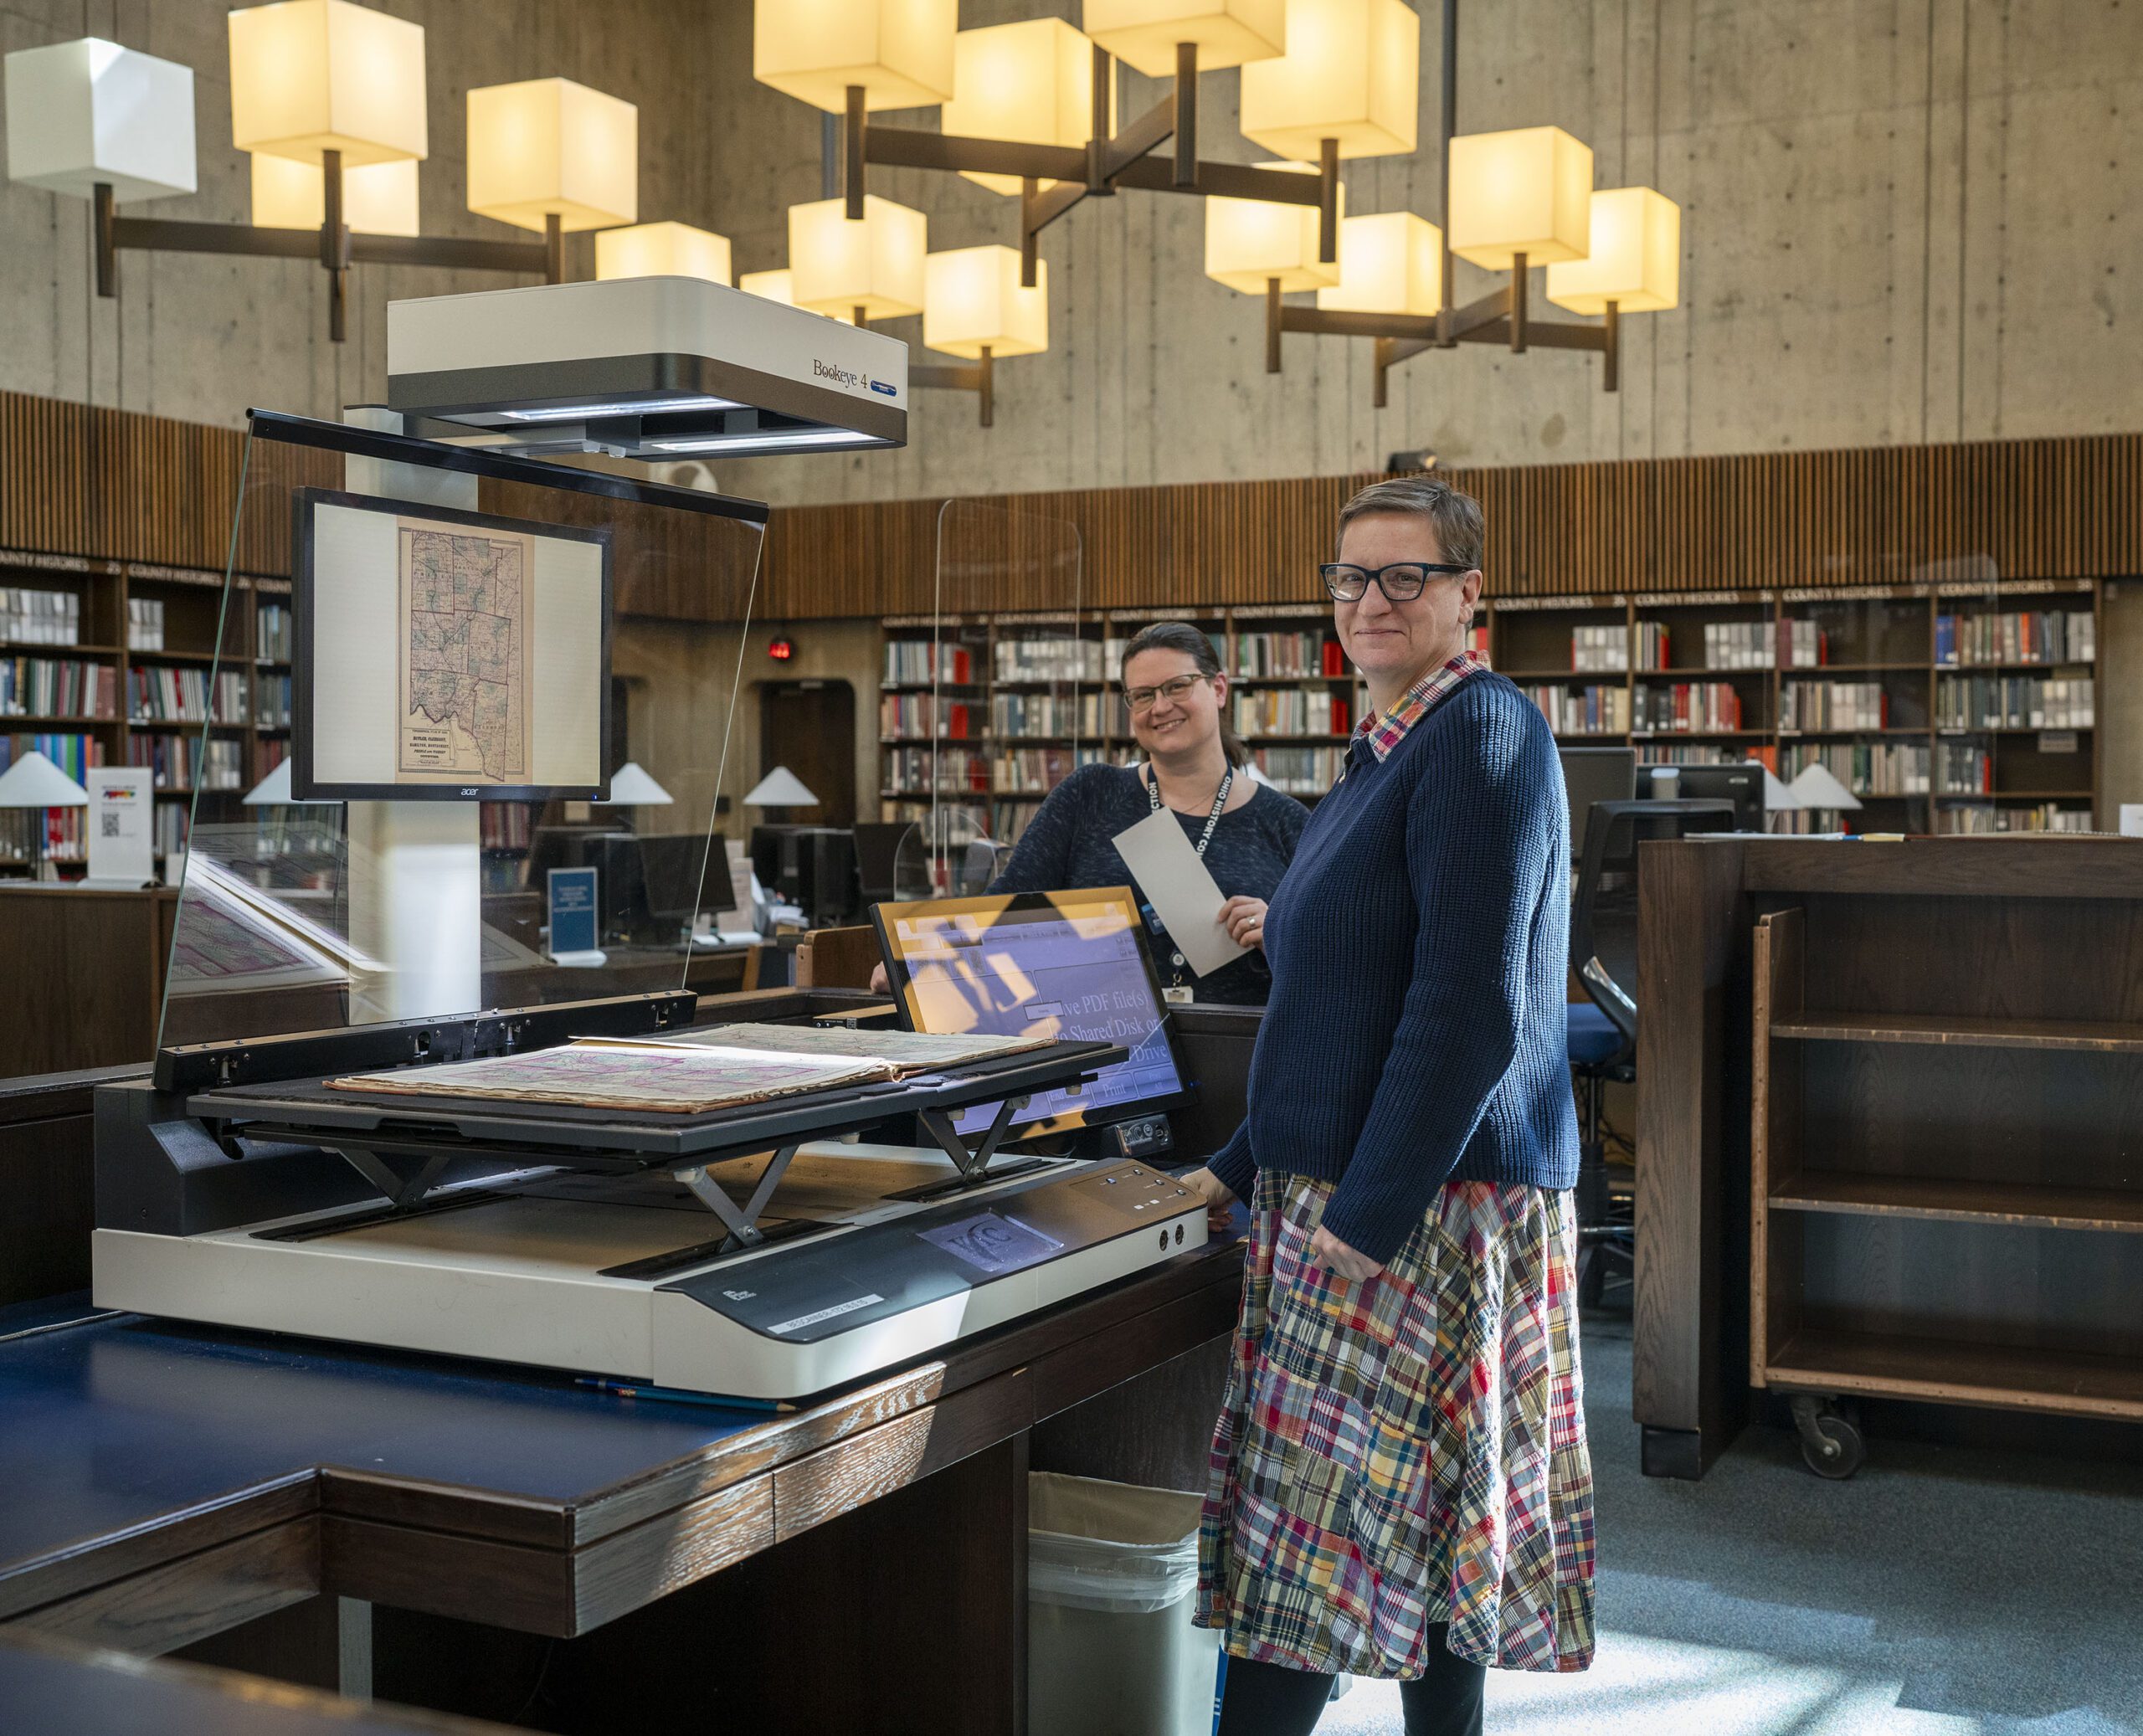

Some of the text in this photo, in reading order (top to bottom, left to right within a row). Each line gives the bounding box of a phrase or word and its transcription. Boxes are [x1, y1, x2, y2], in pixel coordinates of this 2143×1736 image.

[814, 359, 857, 388] Bookeye
[861, 374, 868, 388] 4
[1493, 596, 1539, 611] COUNTY
[1634, 592, 1682, 607] COUNTY
[460, 788, 479, 796] acer
[1218, 776, 1231, 800] OHIO
[1202, 799, 1224, 840] HISTORY
[1081, 994, 1109, 1014] PDF
[1113, 989, 1149, 1012] file(s)
[1070, 1016, 1113, 1042] Shared
[1114, 1016, 1144, 1037] Disk
[1146, 1018, 1159, 1032] or
[1133, 1042, 1167, 1062] Drive
[1102, 1083, 1127, 1097] Print
